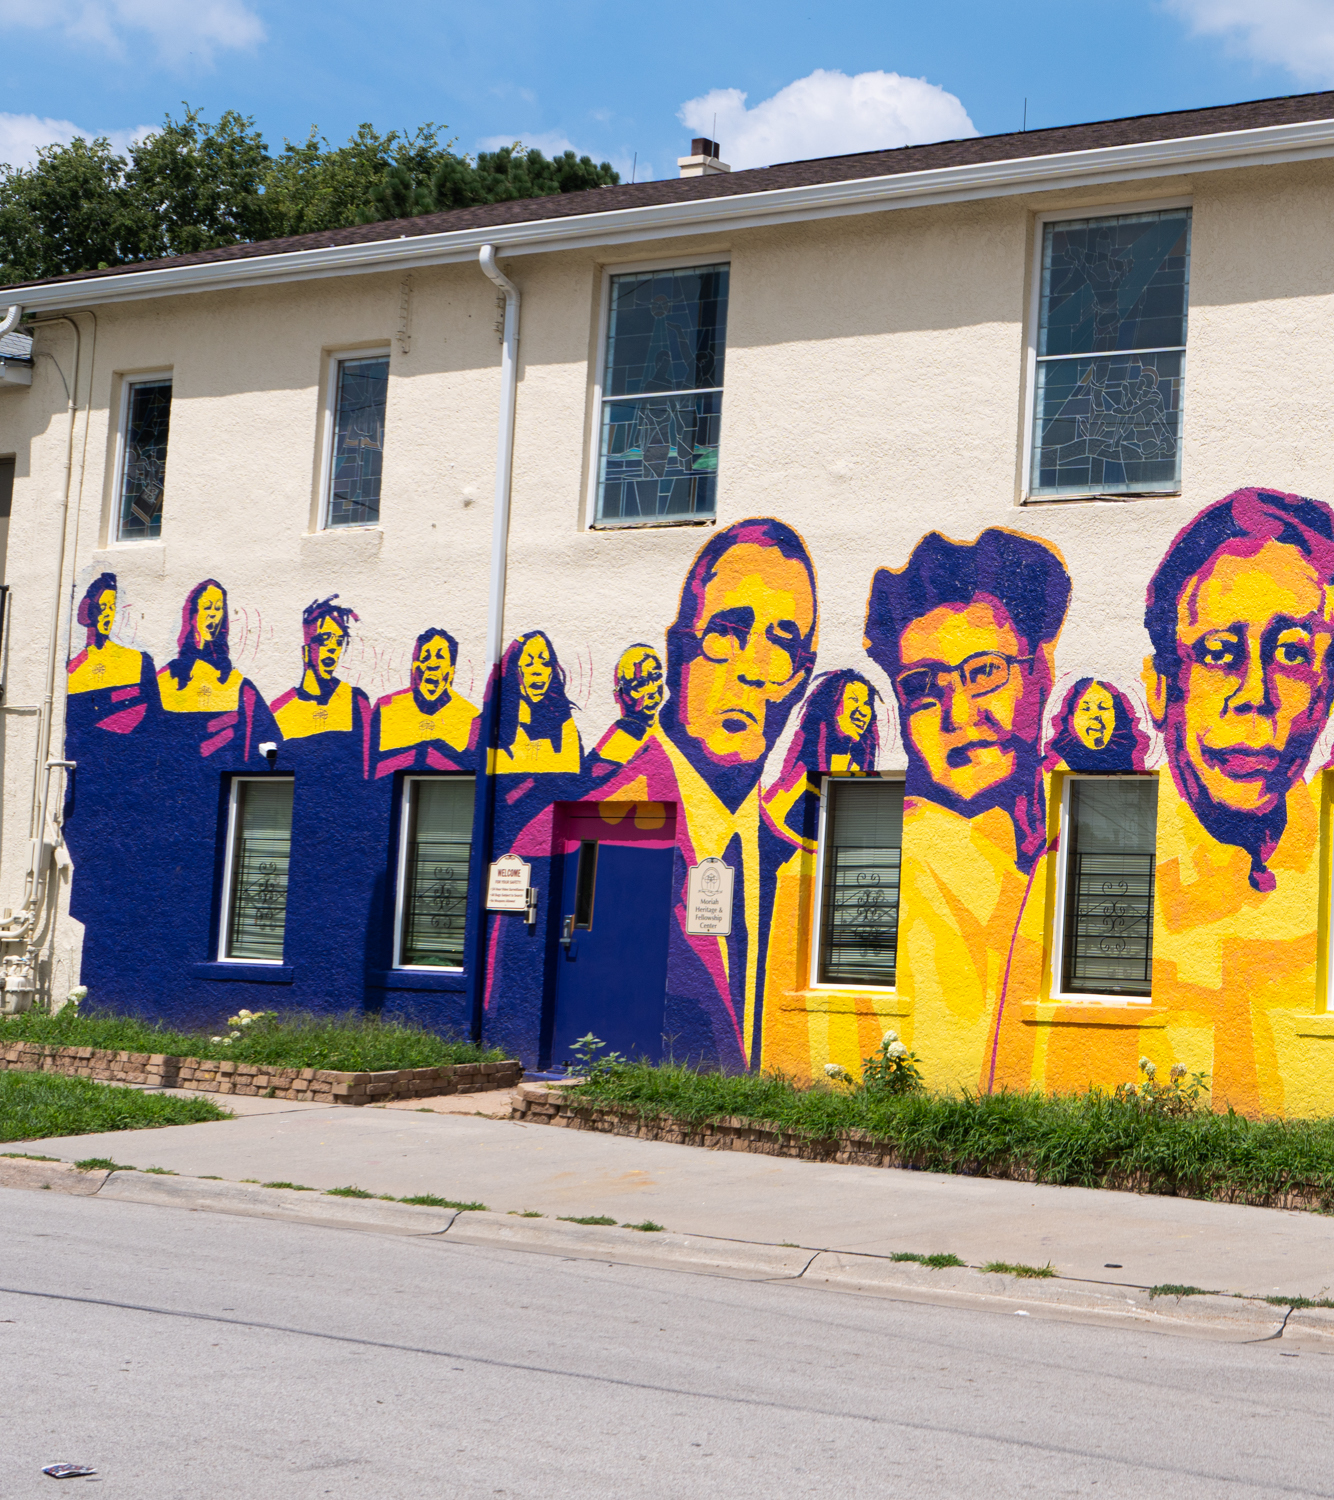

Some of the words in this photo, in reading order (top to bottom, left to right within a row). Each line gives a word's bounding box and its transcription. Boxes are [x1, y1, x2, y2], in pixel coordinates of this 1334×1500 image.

[497, 869, 521, 877] WELCOME
[695, 906, 718, 914] Heritage
[695, 914, 722, 922] Fellowship
